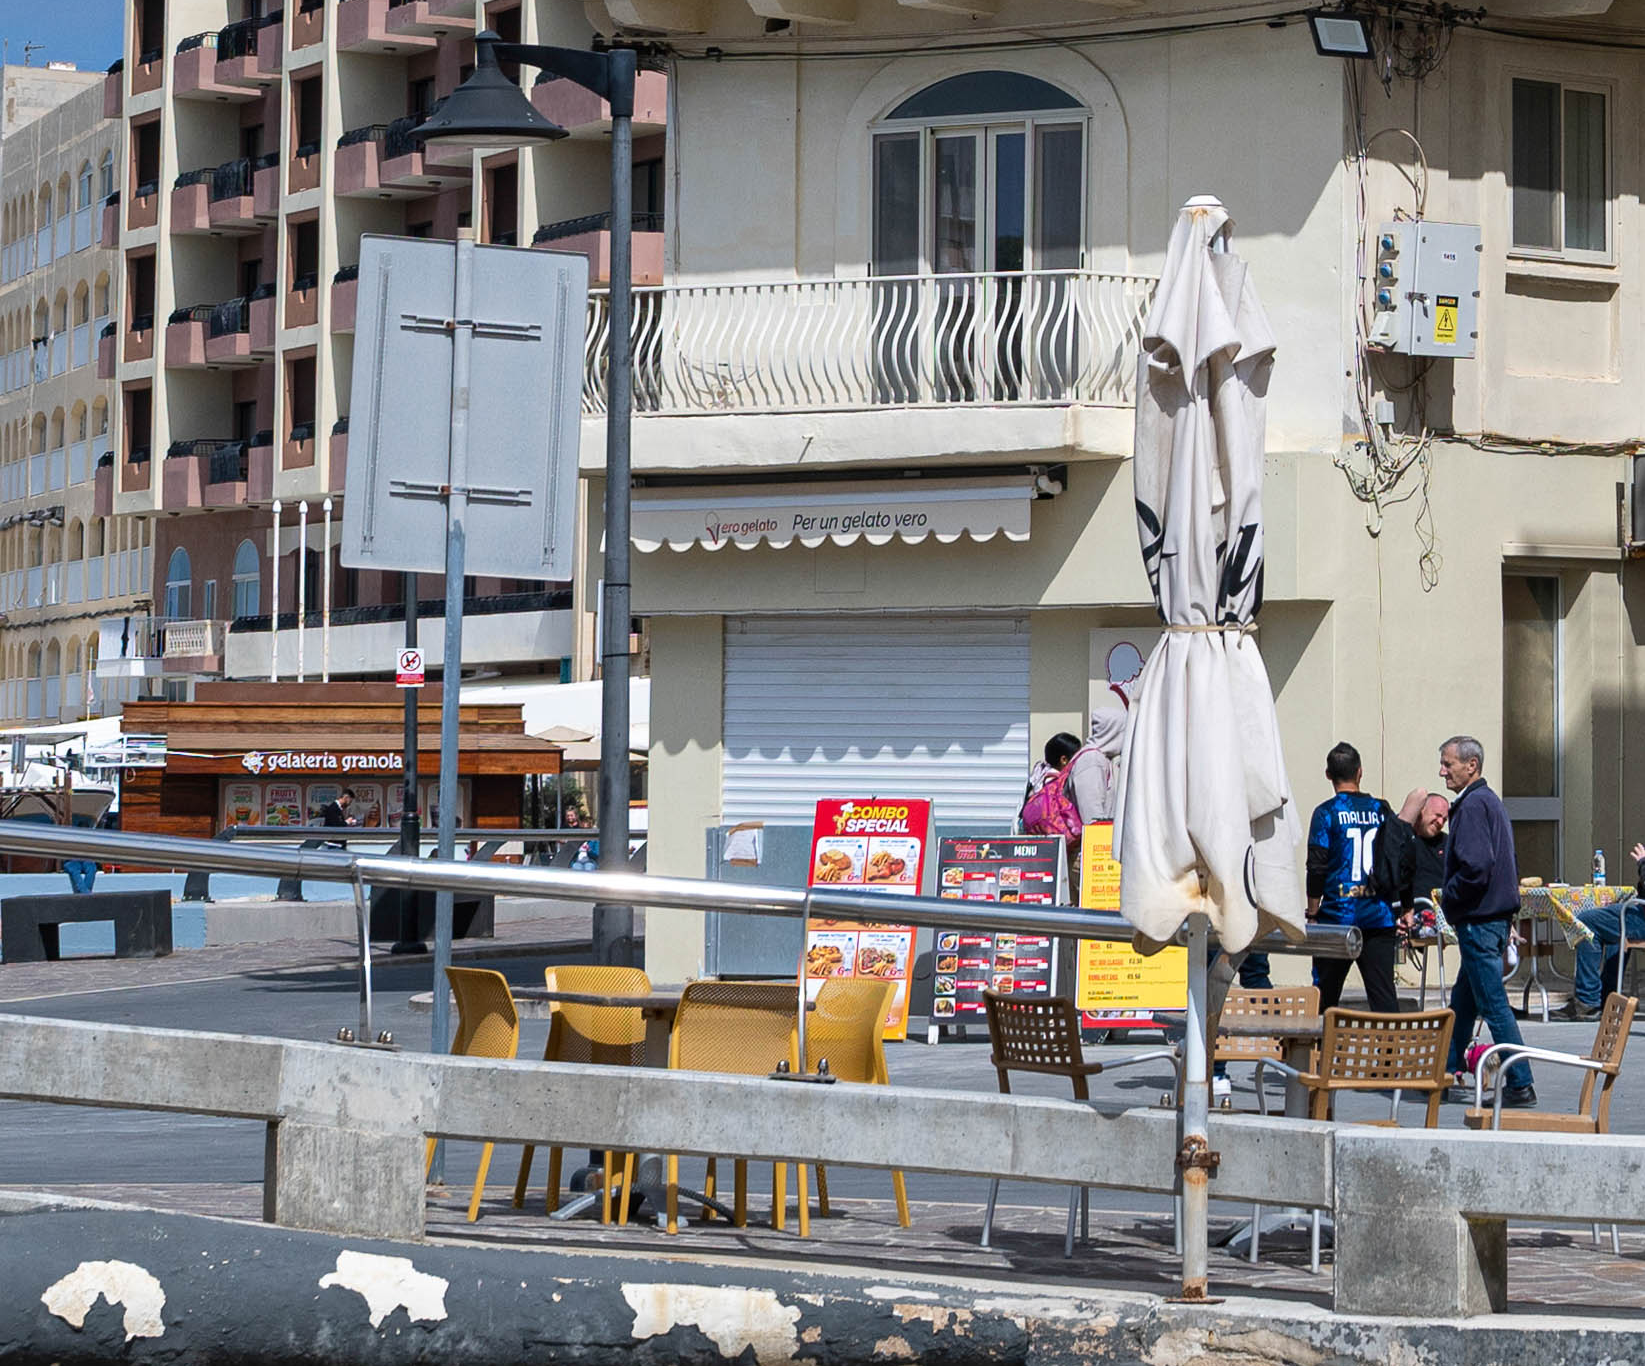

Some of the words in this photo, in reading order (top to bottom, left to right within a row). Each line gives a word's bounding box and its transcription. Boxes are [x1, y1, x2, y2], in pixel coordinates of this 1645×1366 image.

[741, 518, 778, 536] gelato
[793, 514, 815, 531] Per
[820, 516, 838, 530] un
[841, 511, 891, 533] gelato
[895, 513, 928, 527] vero
[268, 752, 338, 772] gelateria
[342, 752, 403, 772] granola
[850, 806, 909, 820] COMBO
[1338, 811, 1380, 825] MALLIA
[845, 819, 910, 833] SPECIAL
[1013, 845, 1038, 857] MENU
